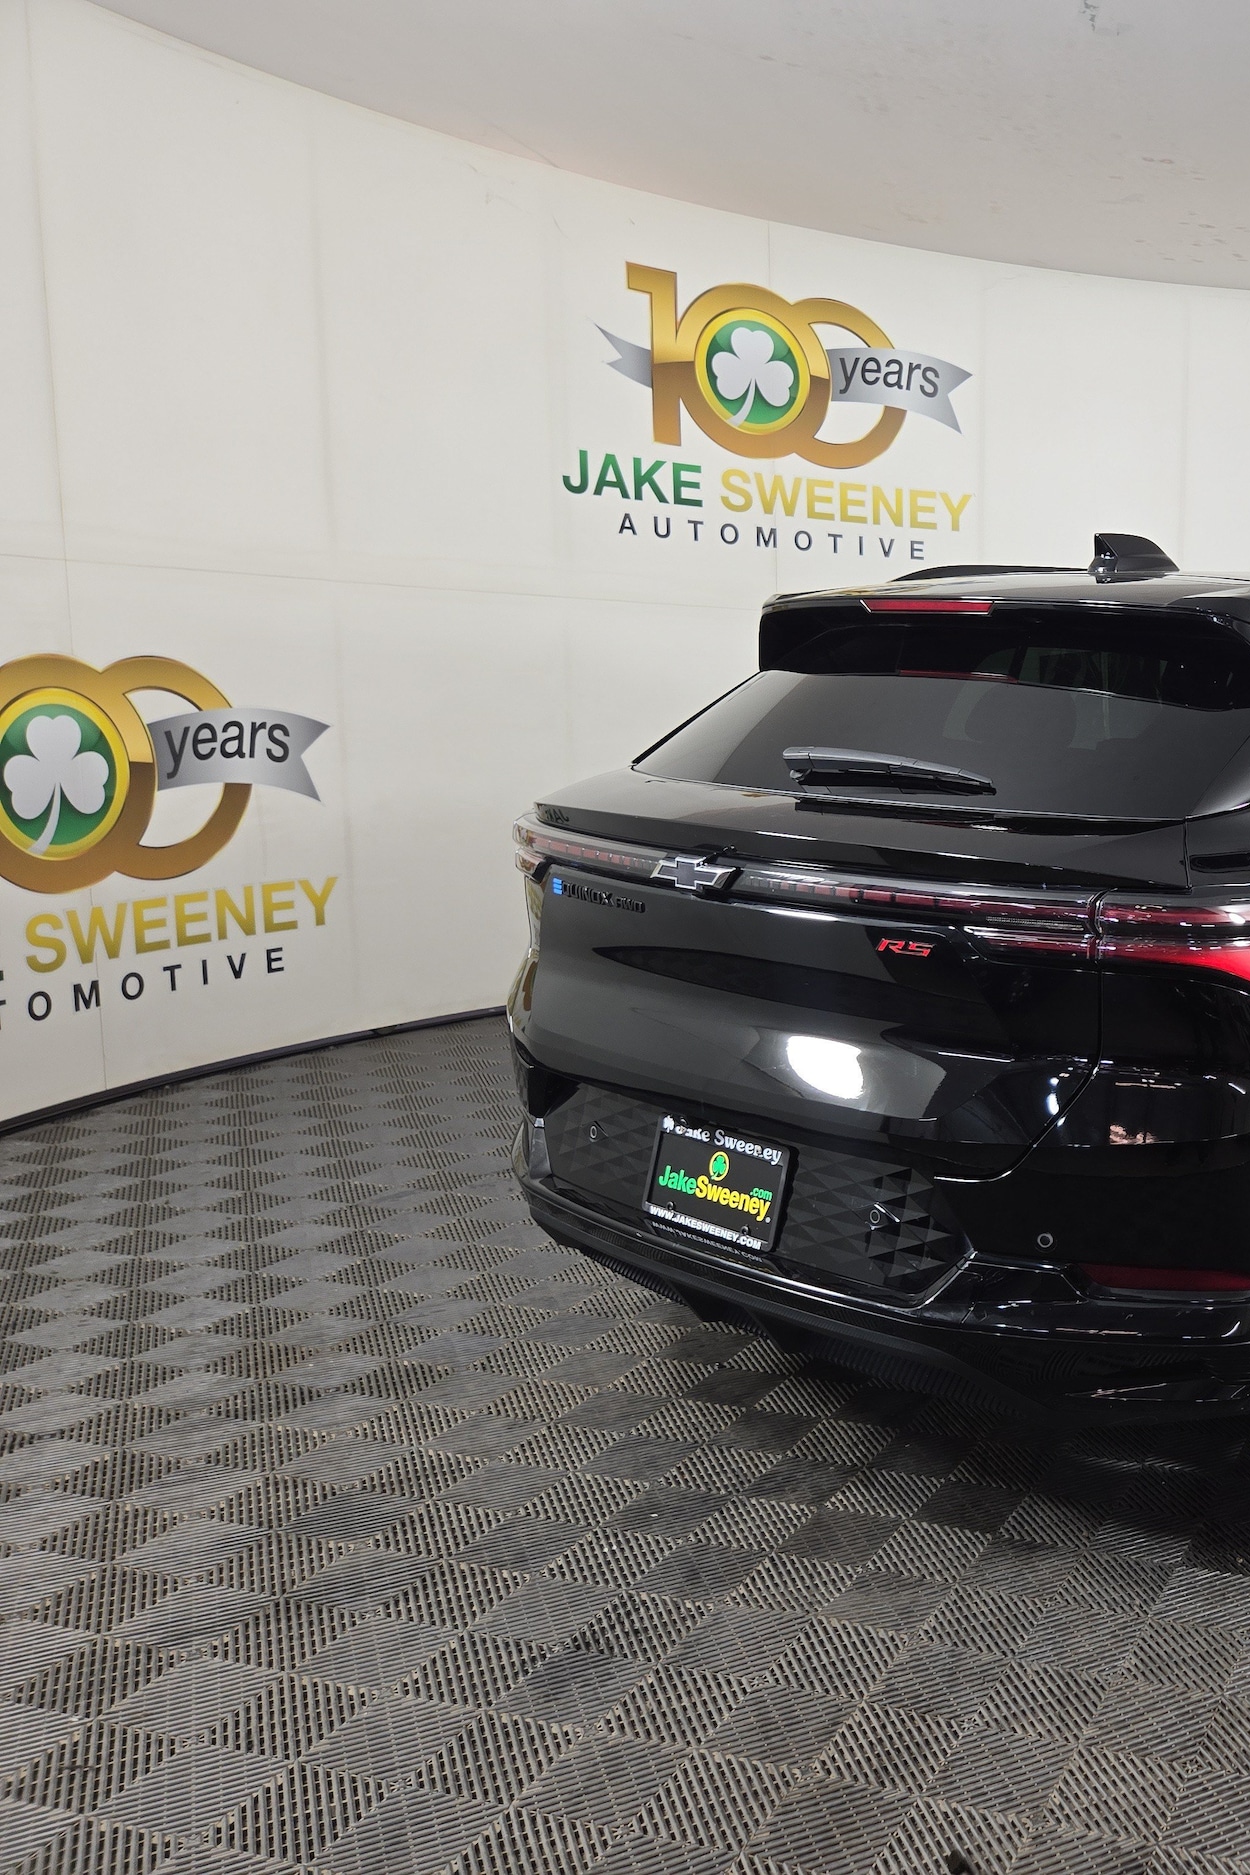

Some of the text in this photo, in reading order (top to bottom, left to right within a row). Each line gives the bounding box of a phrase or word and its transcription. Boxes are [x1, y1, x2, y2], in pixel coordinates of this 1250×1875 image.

[625, 261, 907, 469] 100
[838, 354, 940, 399] years
[562, 449, 972, 532] JAKE SWEENEY
[618, 513, 925, 560] AUTOMOTIVE
[164, 719, 291, 780] years
[25, 876, 338, 974] SWEENEY
[876, 938, 936, 957] RS
[650, 1205, 763, 1250] WWW.JAKESWEENEY.COM
